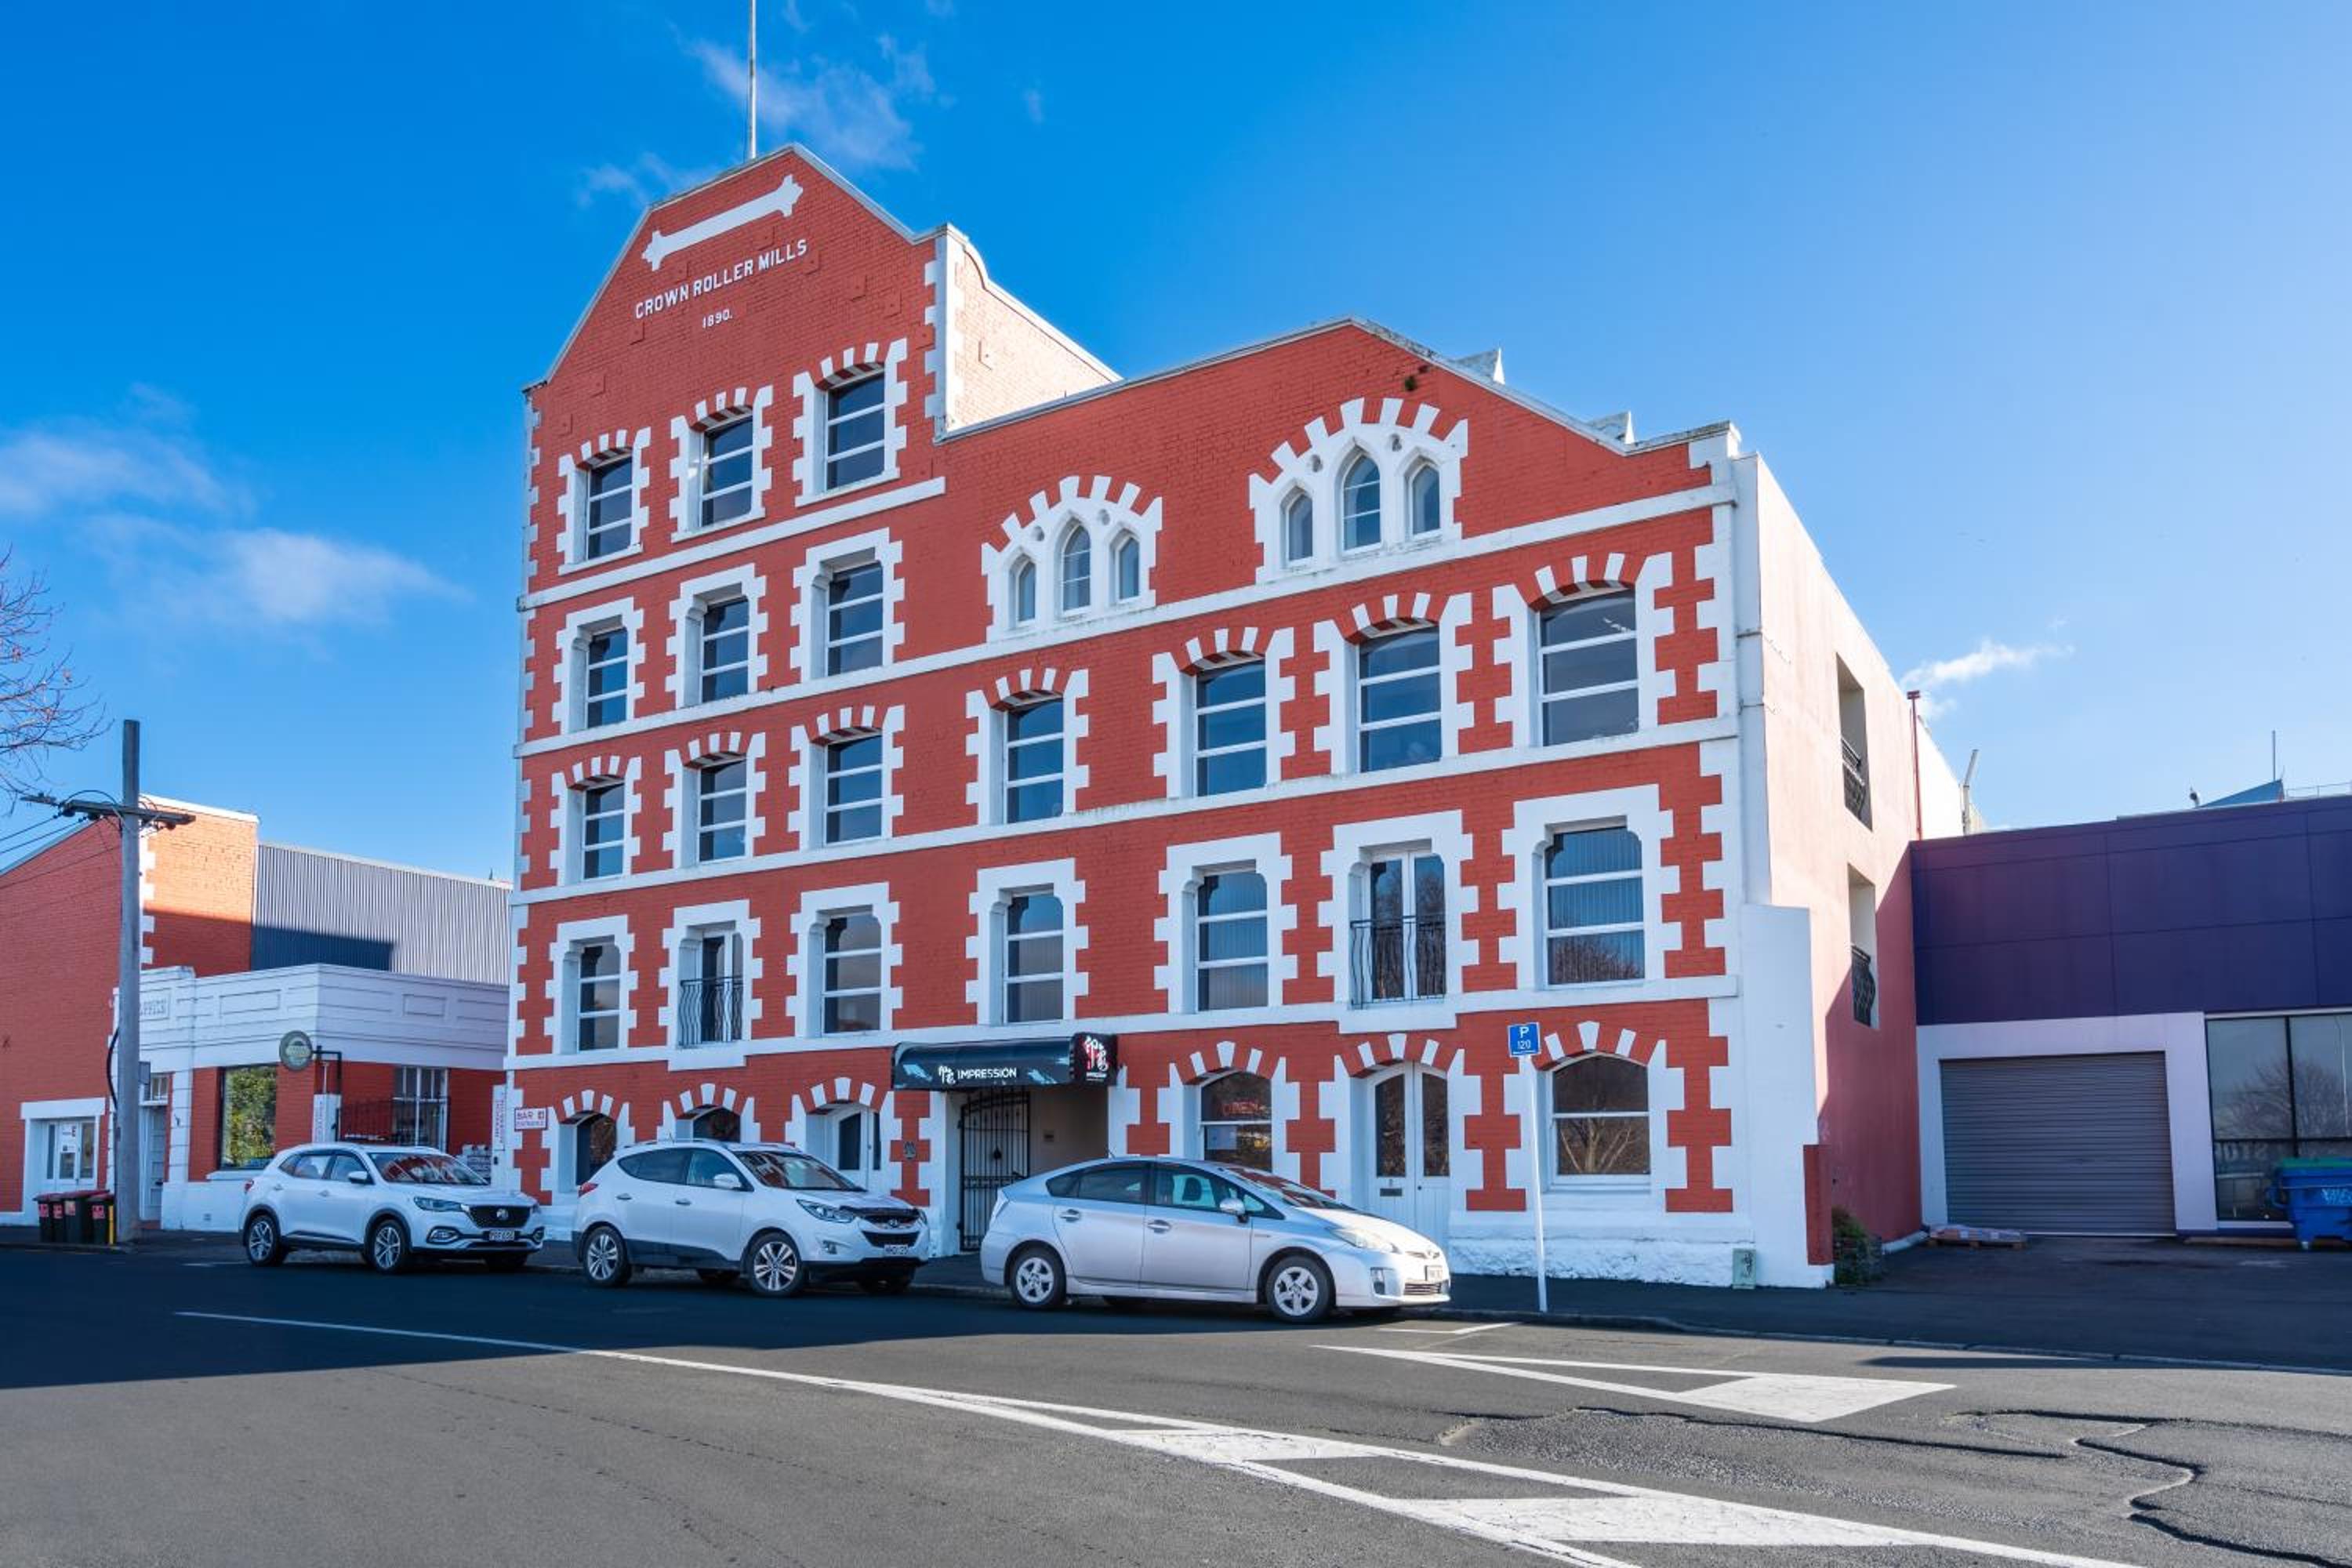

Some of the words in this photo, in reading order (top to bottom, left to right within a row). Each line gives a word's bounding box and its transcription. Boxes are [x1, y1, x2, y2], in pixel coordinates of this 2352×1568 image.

[635, 284, 688, 318] CROWN
[693, 260, 753, 297] ROLLER
[758, 238, 808, 270] MILLS
[1519, 1026, 1530, 1039] P
[1517, 1040, 1531, 1050] 120
[957, 1067, 1017, 1080] IMPRESSION
[517, 1110, 534, 1120] BAR
